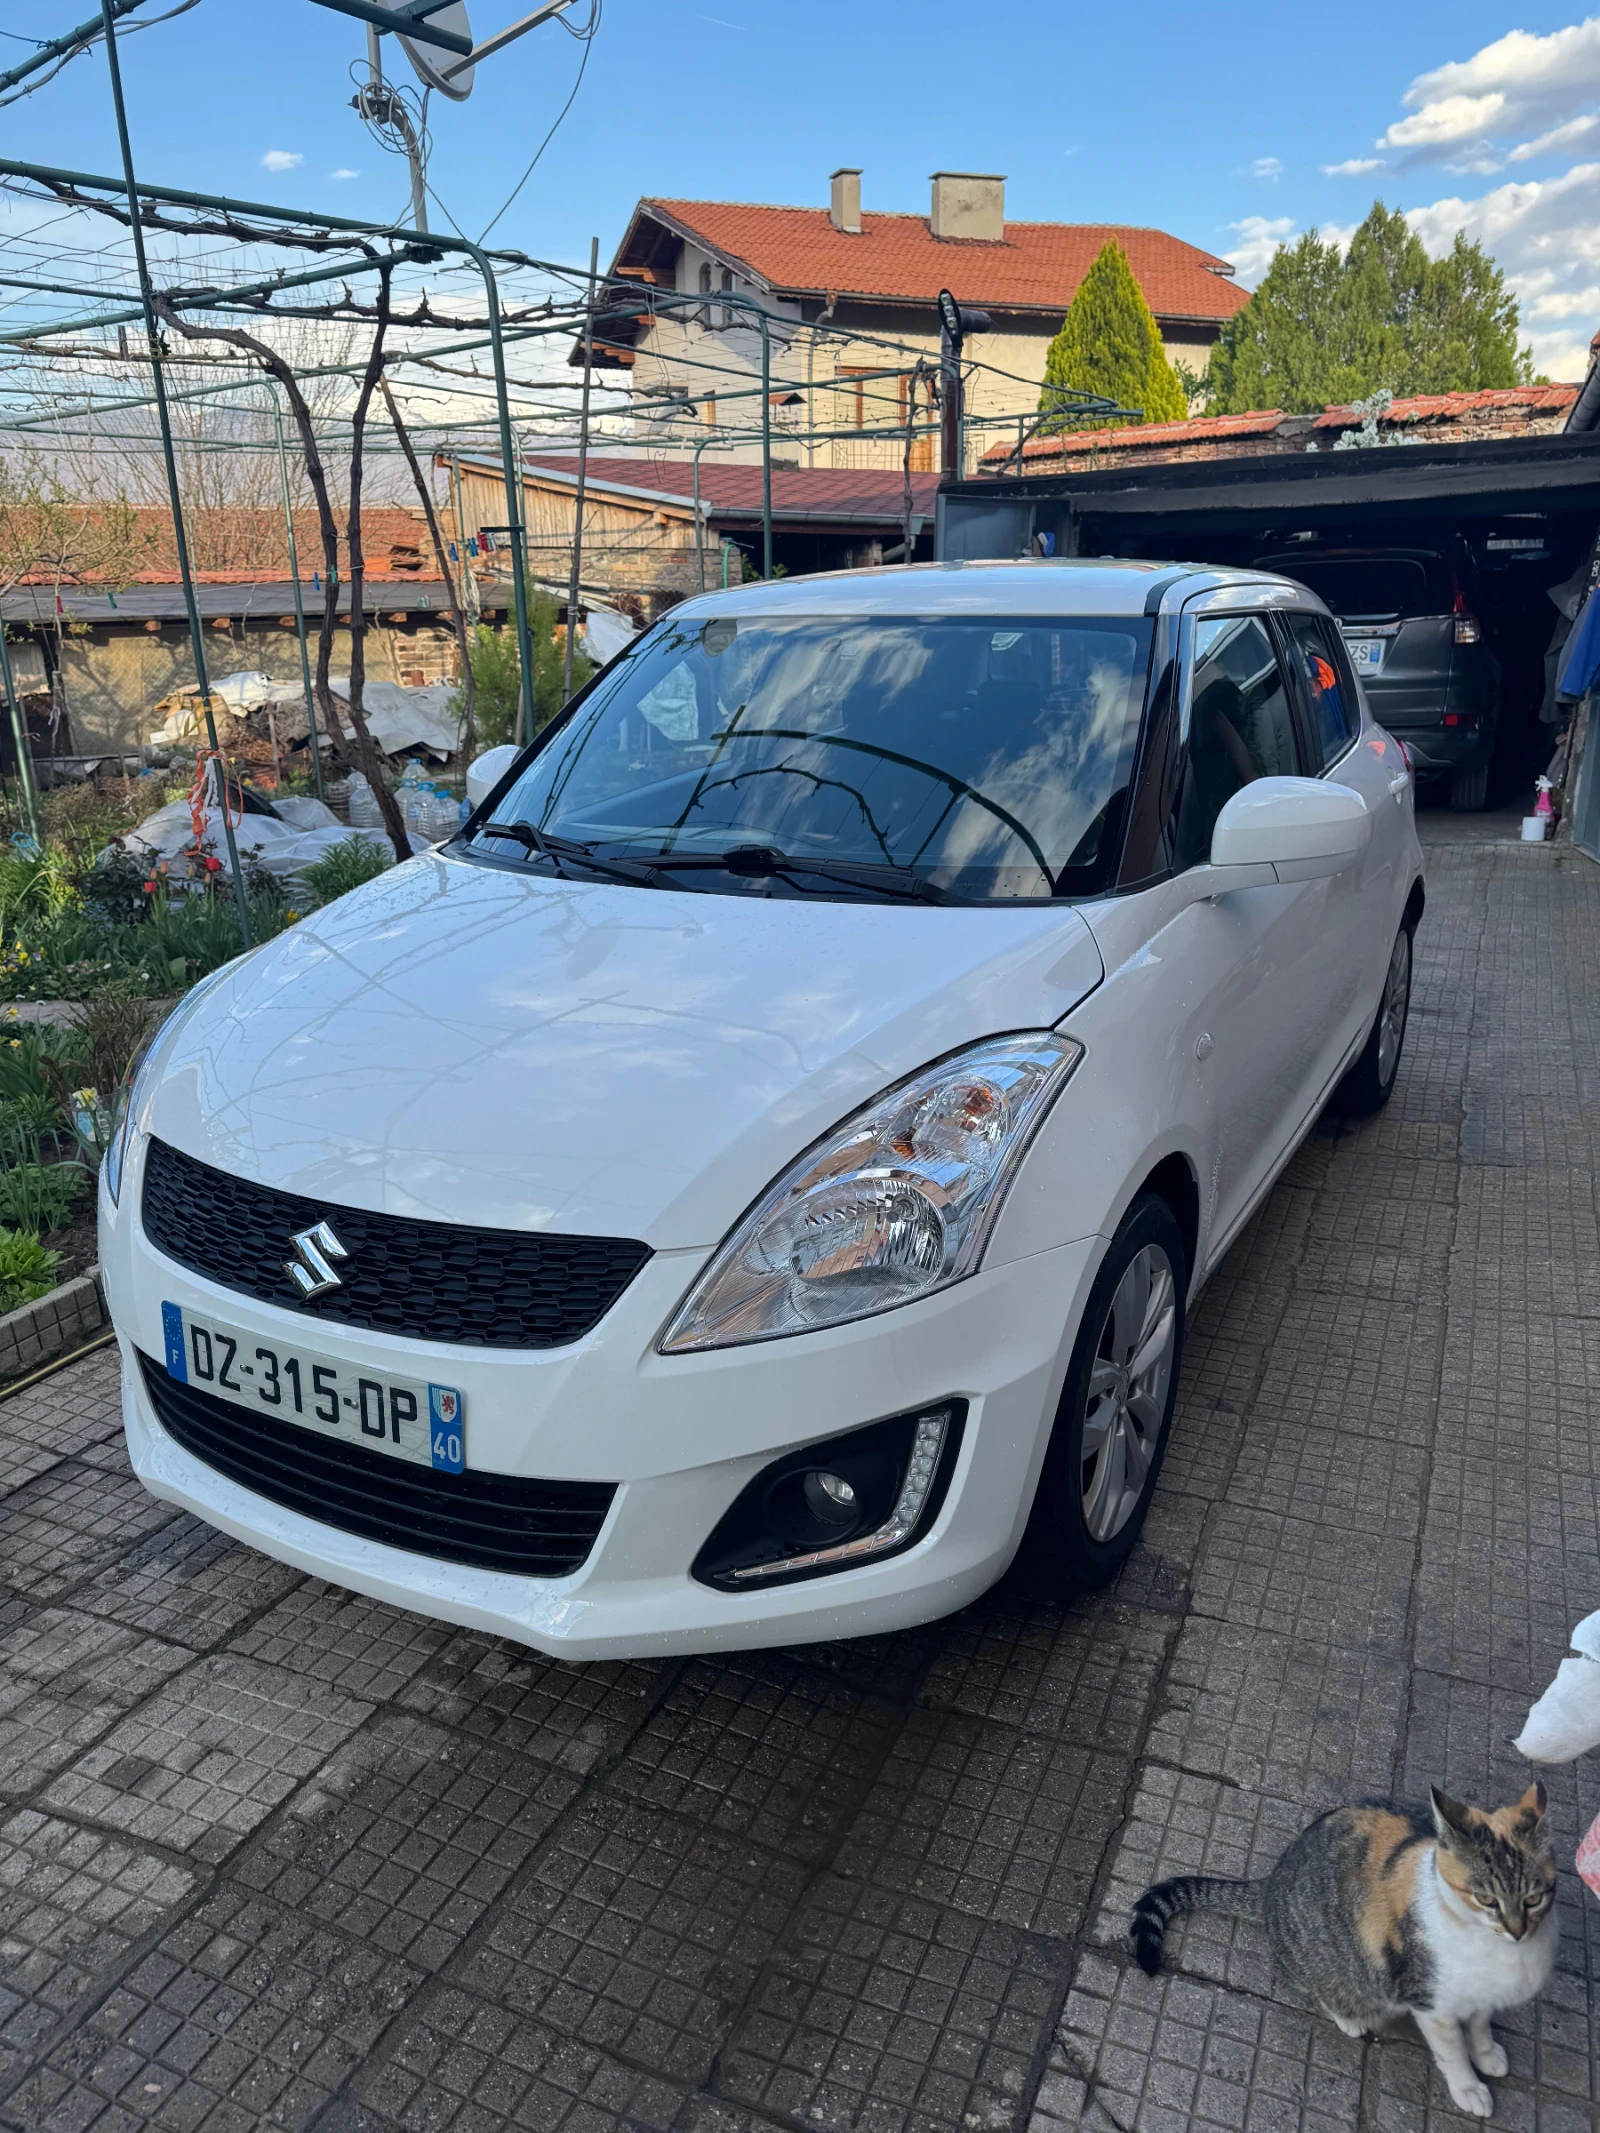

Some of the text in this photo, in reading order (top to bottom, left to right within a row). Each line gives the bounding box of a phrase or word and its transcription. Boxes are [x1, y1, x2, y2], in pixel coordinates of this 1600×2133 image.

[172, 1348, 179, 1365] F
[191, 1324, 418, 1444] DZ-315-DP
[433, 1431, 461, 1463] 40
